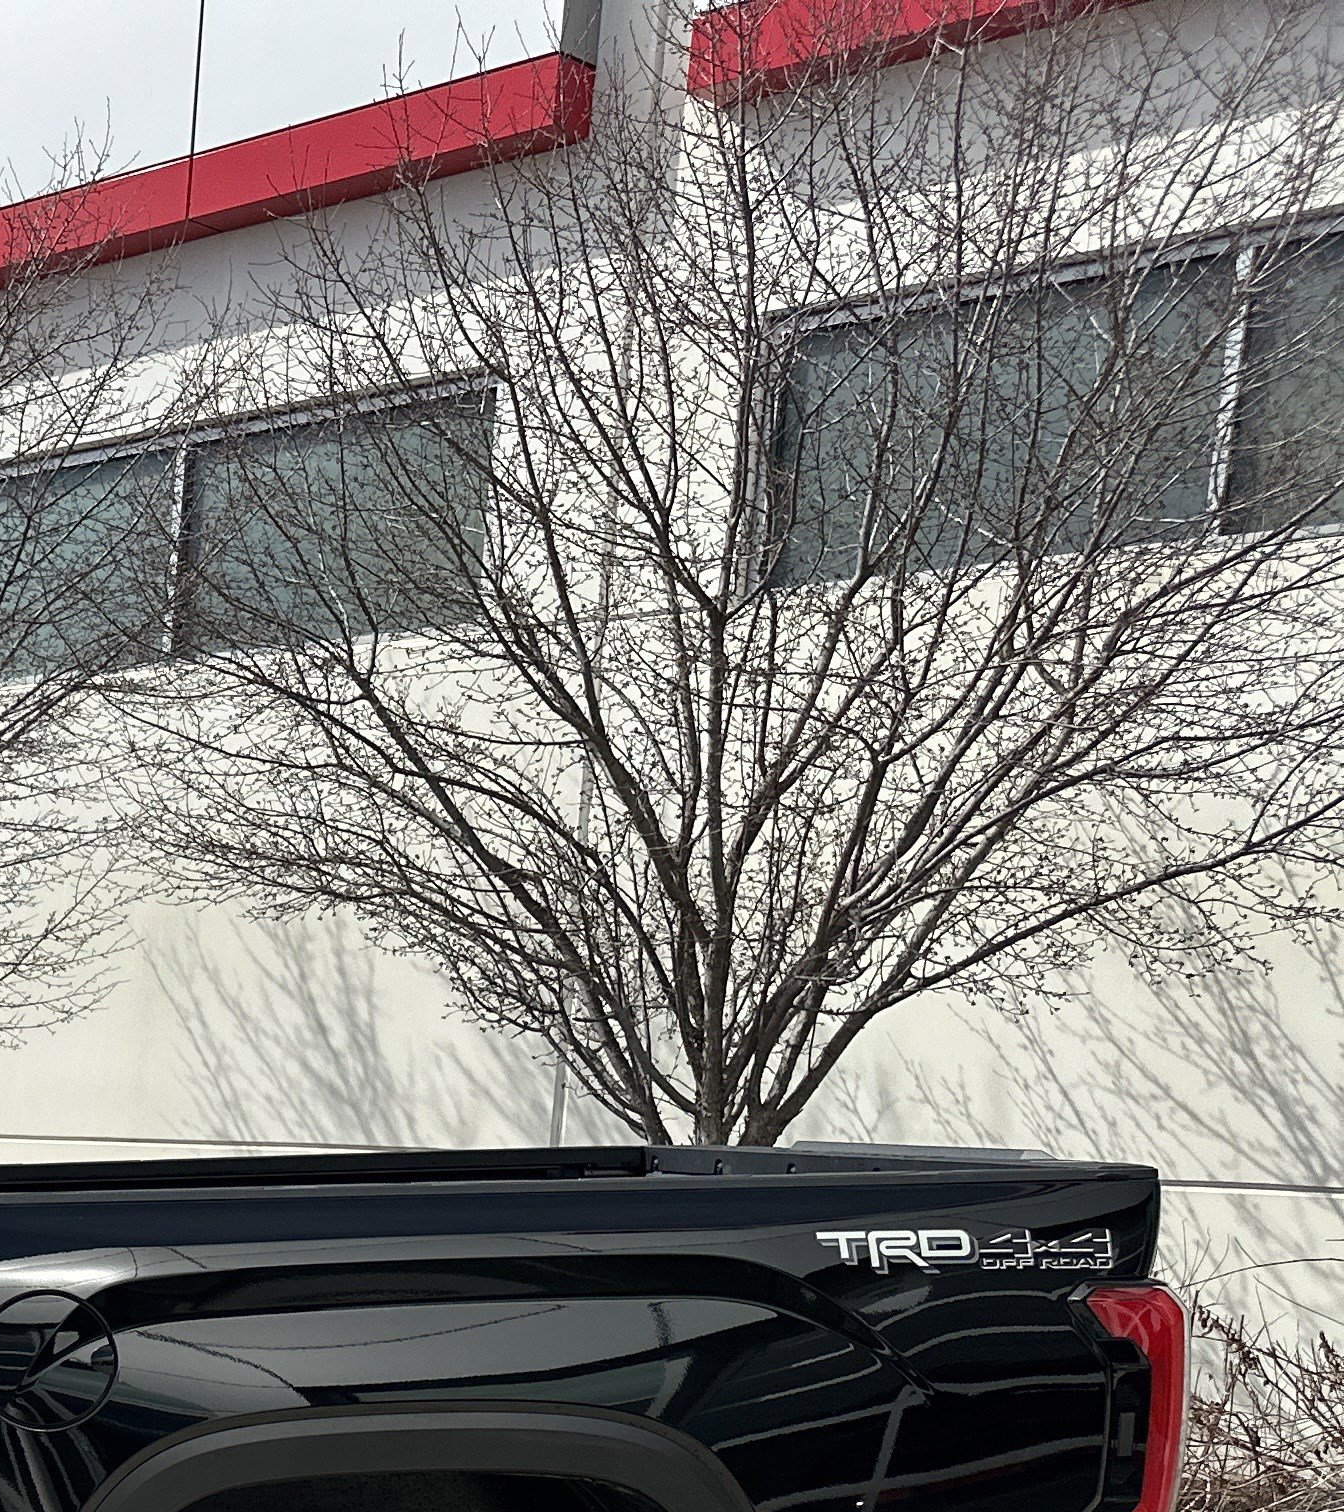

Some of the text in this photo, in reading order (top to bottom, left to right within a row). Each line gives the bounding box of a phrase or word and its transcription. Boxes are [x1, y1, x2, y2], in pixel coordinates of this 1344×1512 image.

[816, 1228, 1113, 1275] TRD 4x4
[980, 1256, 1113, 1270] OFF ROAD
